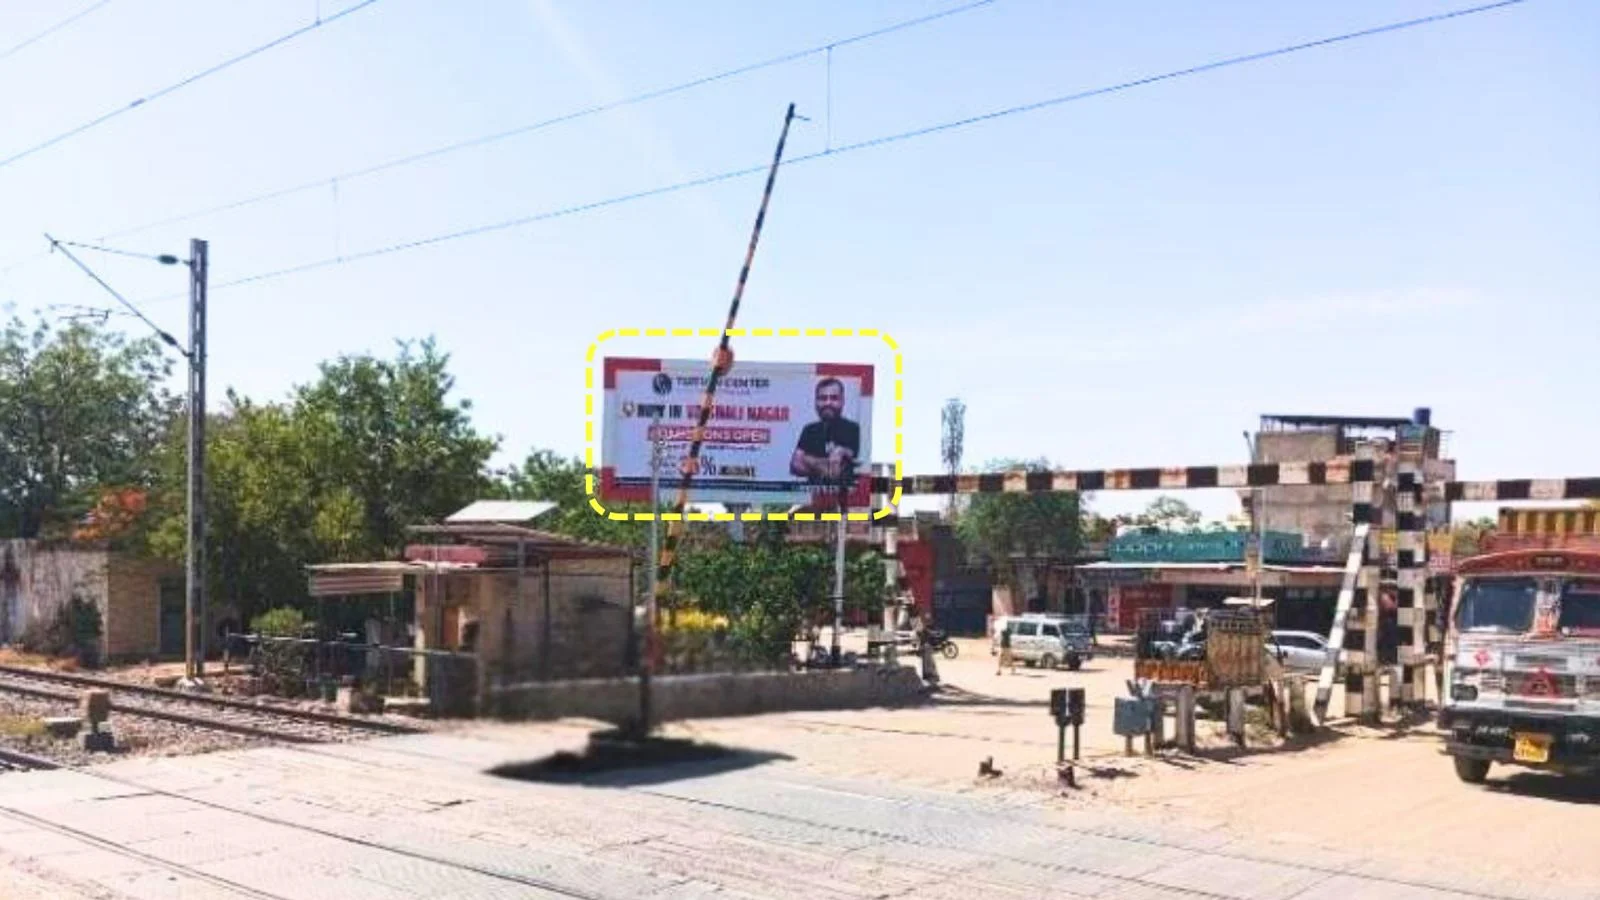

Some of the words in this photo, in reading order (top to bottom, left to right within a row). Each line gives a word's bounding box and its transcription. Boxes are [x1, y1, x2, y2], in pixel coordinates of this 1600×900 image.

[676, 376, 723, 387] TUITIN
[725, 377, 770, 389] CENTER
[669, 404, 682, 419] IN
[686, 404, 742, 420] VAHALI
[747, 405, 790, 421] NAGAR
[650, 427, 731, 441] DMISONS
[733, 430, 767, 443] OPEN
